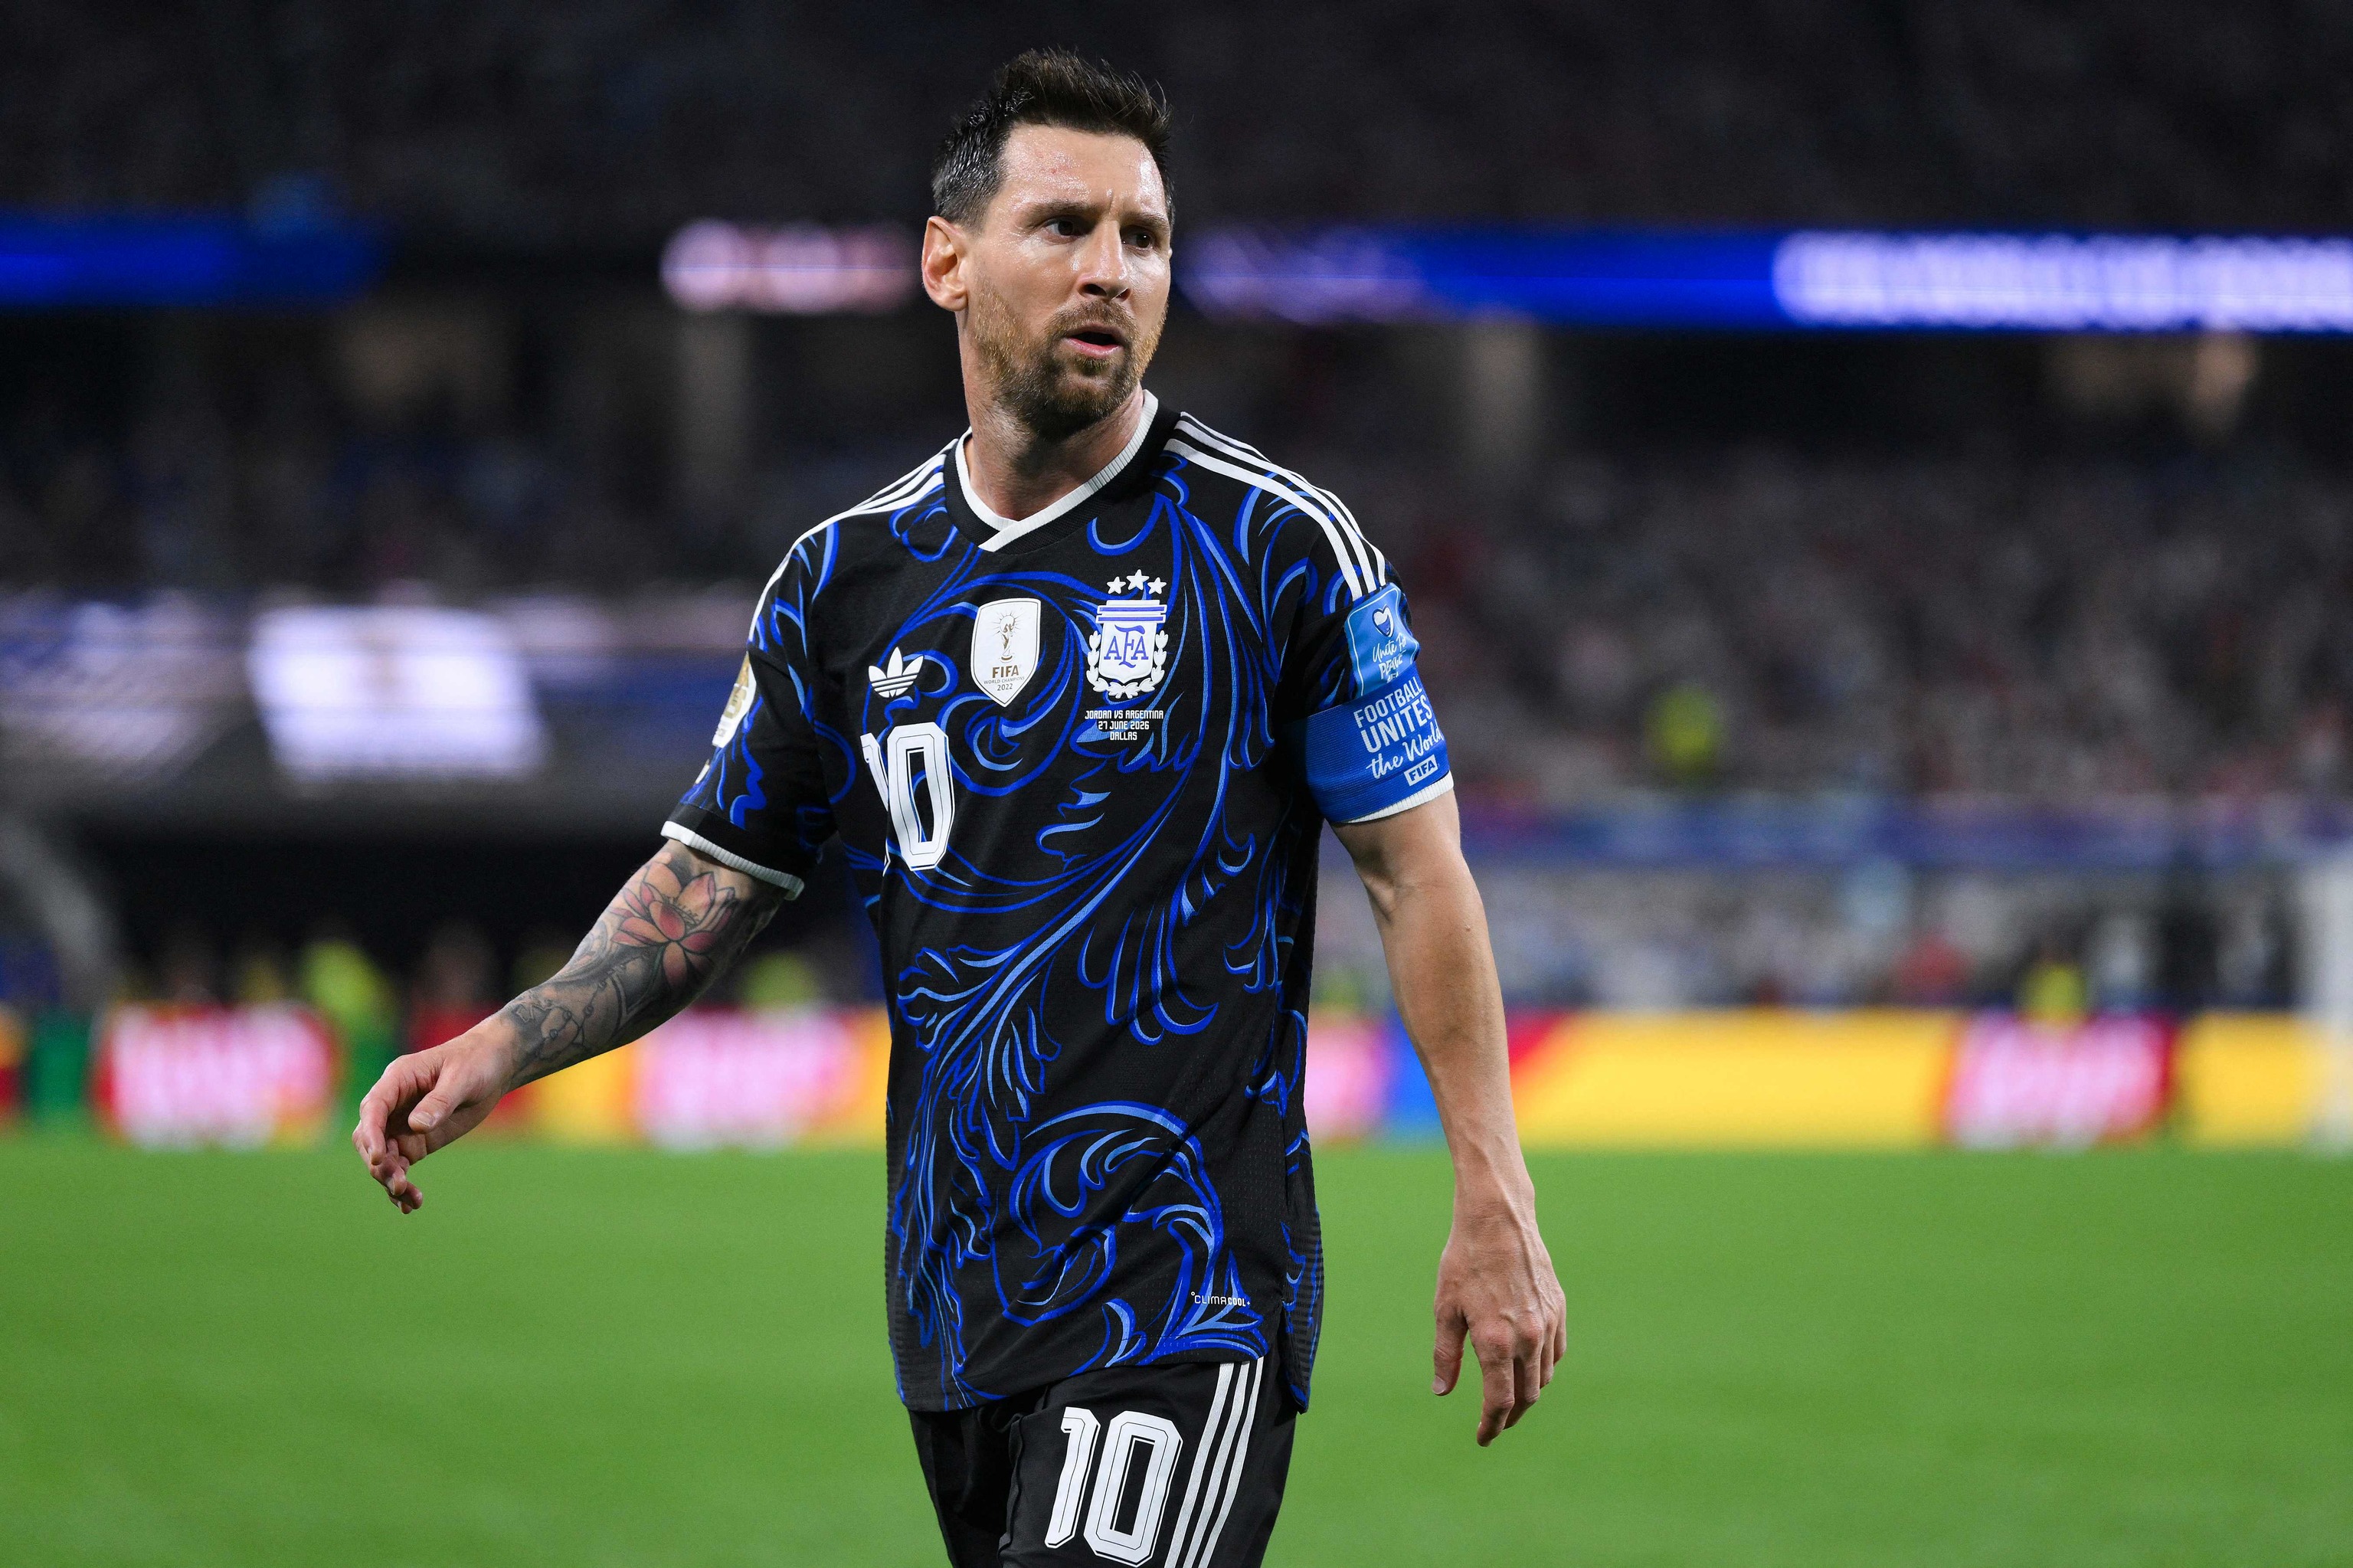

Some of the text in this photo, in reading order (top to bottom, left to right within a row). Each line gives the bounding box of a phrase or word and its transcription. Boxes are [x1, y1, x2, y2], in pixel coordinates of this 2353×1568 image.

[1104, 624, 1149, 669] AFA
[1373, 640, 1397, 663] Unite
[992, 665, 1019, 679] FIFA
[1353, 676, 1422, 728] FOOTBALL
[1085, 710, 1163, 719] JORDAN VS ARGENTINA
[1098, 721, 1150, 730] 27 JUNE 2026
[1360, 695, 1432, 753] UNITES
[1110, 732, 1137, 741] DALLAS
[1366, 719, 1445, 779] the World
[1406, 758, 1437, 782] FIFA
[1045, 1406, 1183, 1568] 10
